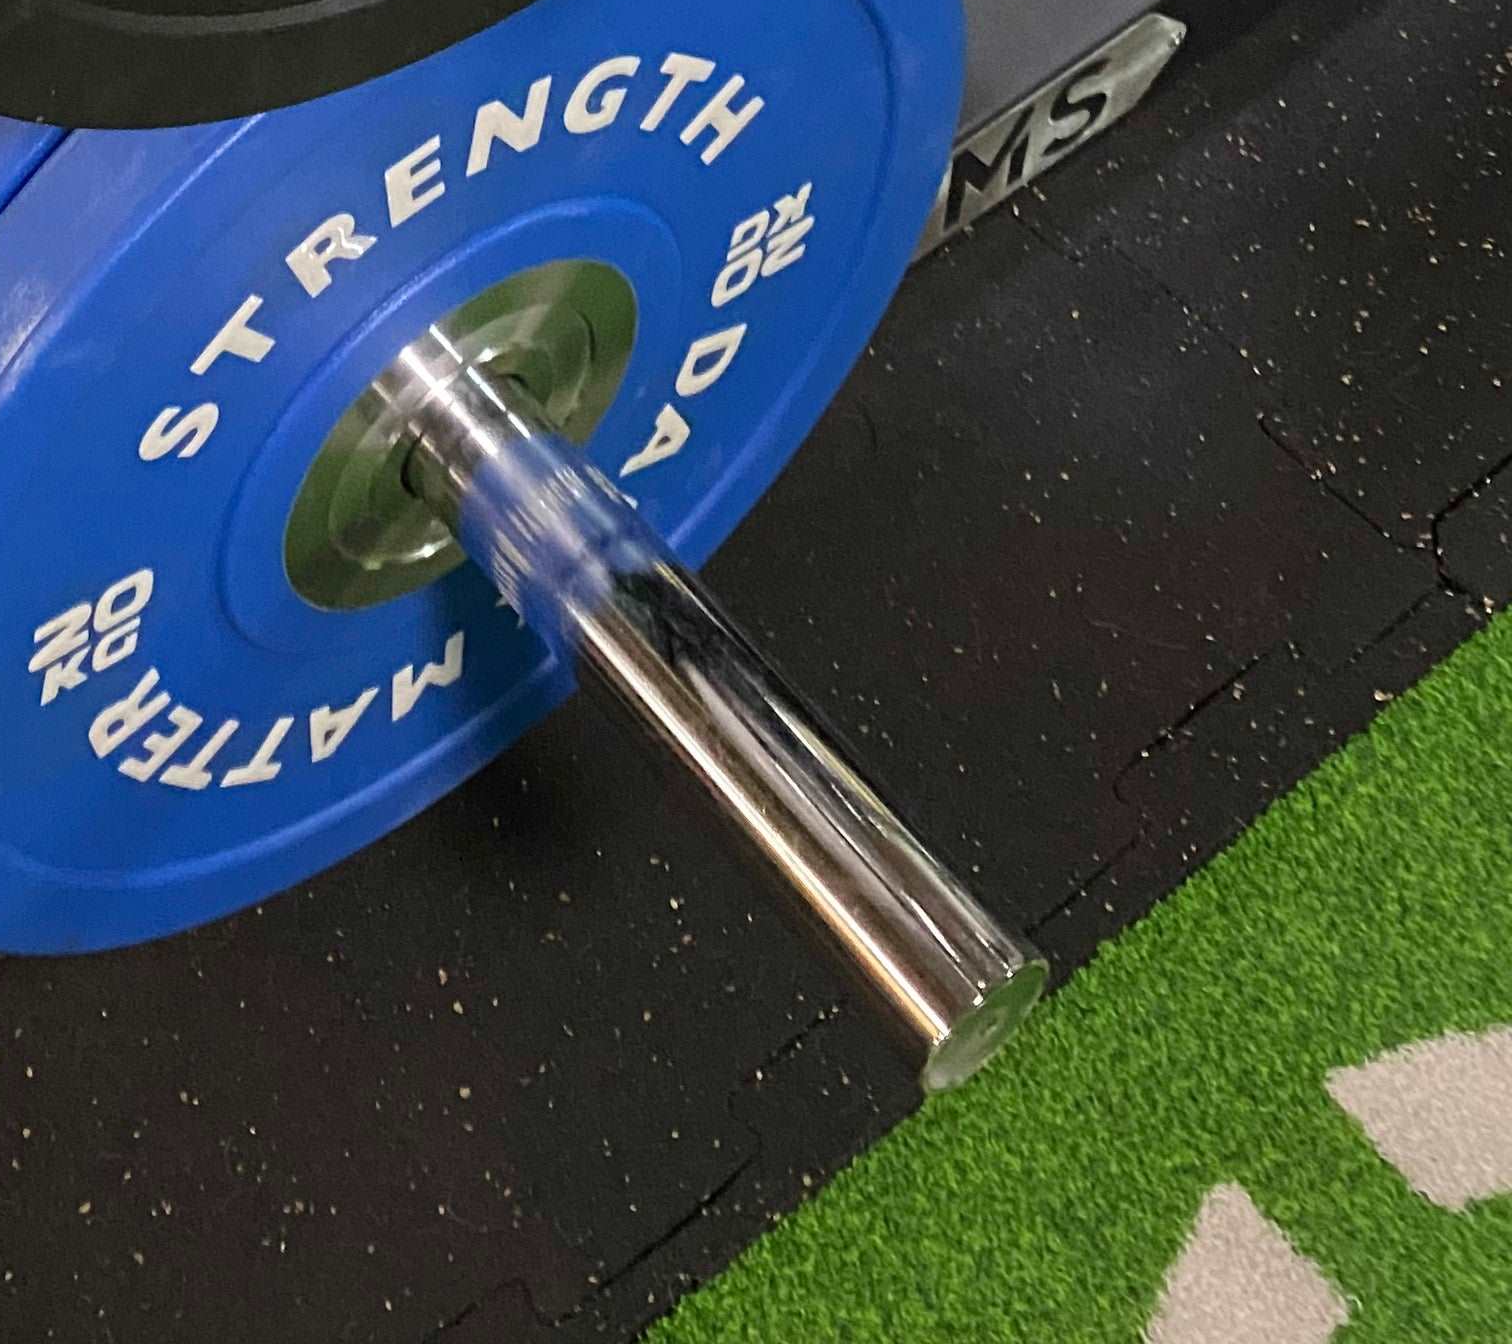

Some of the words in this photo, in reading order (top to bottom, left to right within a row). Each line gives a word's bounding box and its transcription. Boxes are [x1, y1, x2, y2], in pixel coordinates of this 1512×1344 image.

[138, 52, 765, 461] STRENGTH
[711, 215, 815, 309] 20
[726, 182, 814, 263] KG
[619, 323, 748, 477] DA
[28, 569, 155, 674] 20
[40, 615, 142, 708] KG
[87, 631, 465, 791] MATTER
